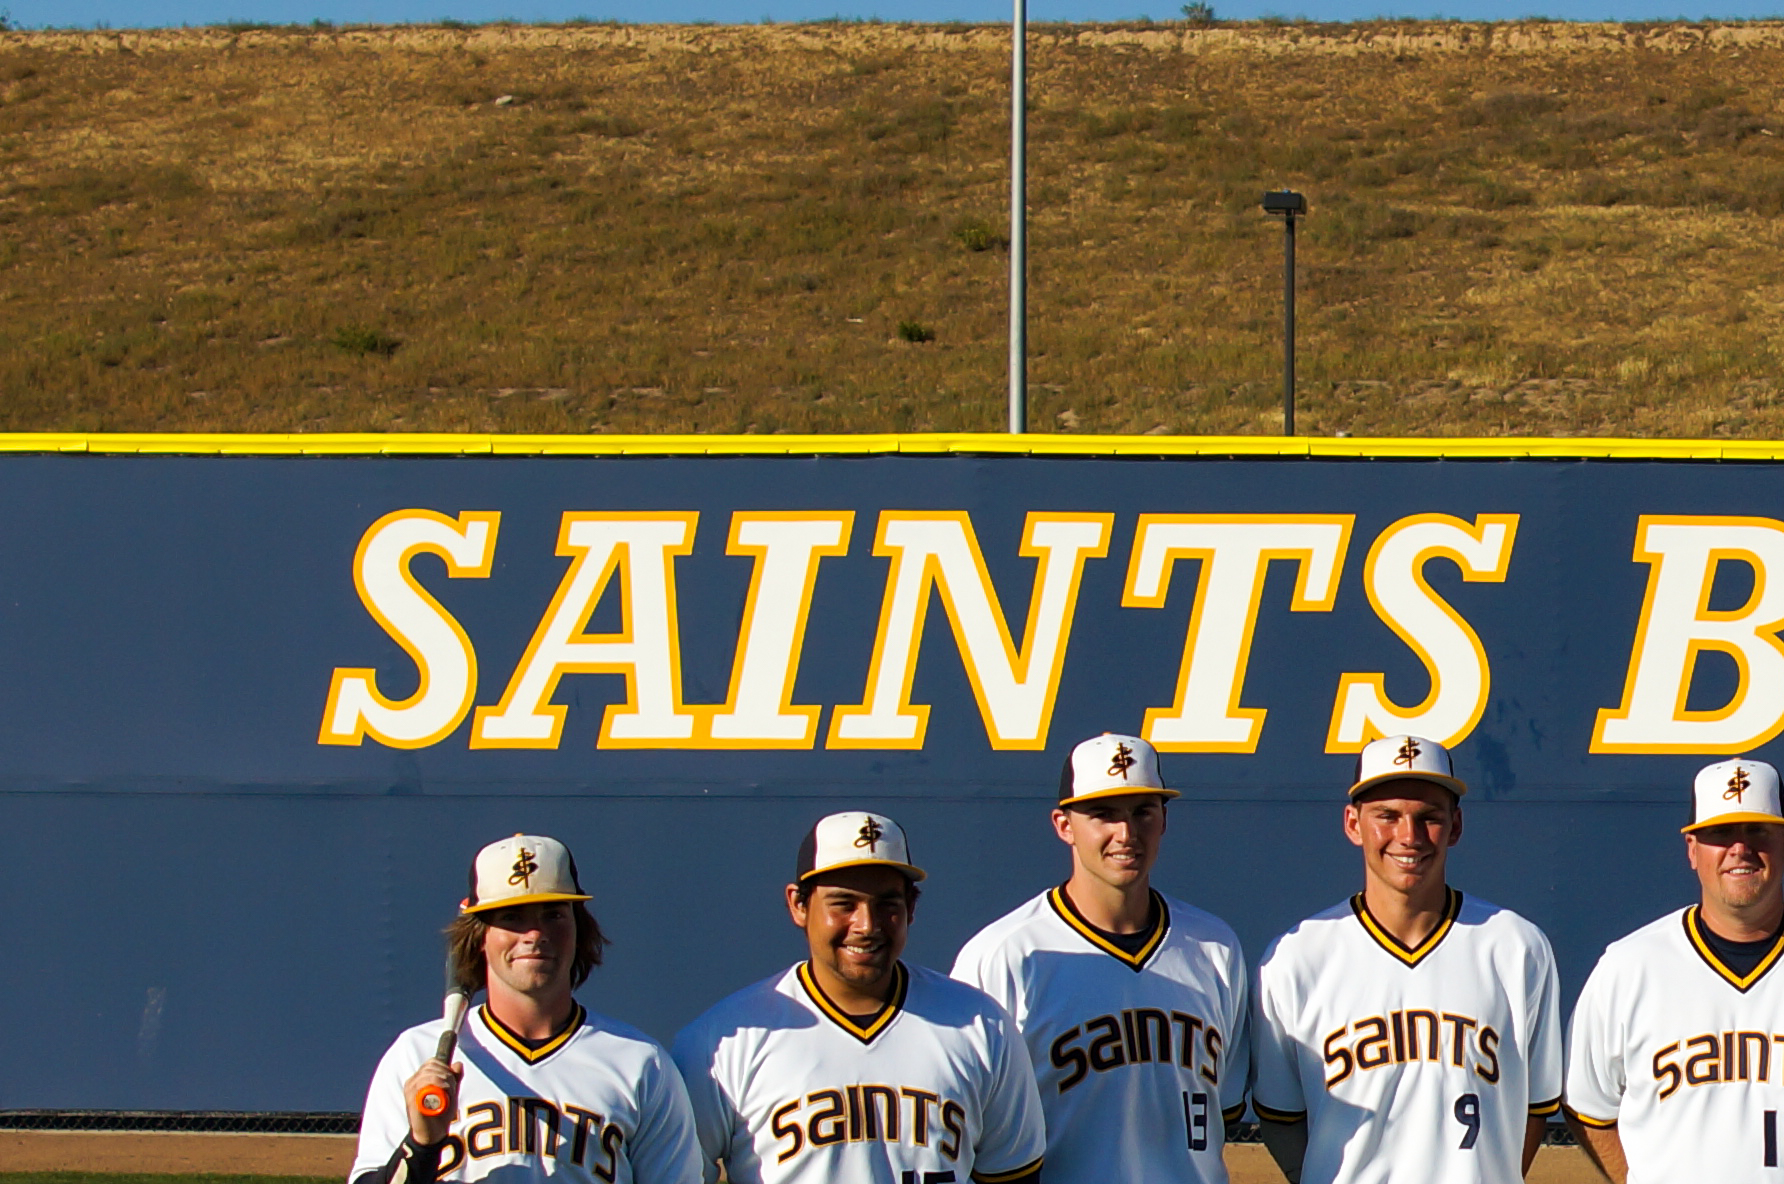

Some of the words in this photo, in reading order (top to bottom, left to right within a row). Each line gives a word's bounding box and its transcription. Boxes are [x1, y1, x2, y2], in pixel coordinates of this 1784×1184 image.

[318, 508, 1520, 754] SAINTS
[1184, 1091, 1208, 1151] 13
[1454, 1093, 1480, 1149] 9
